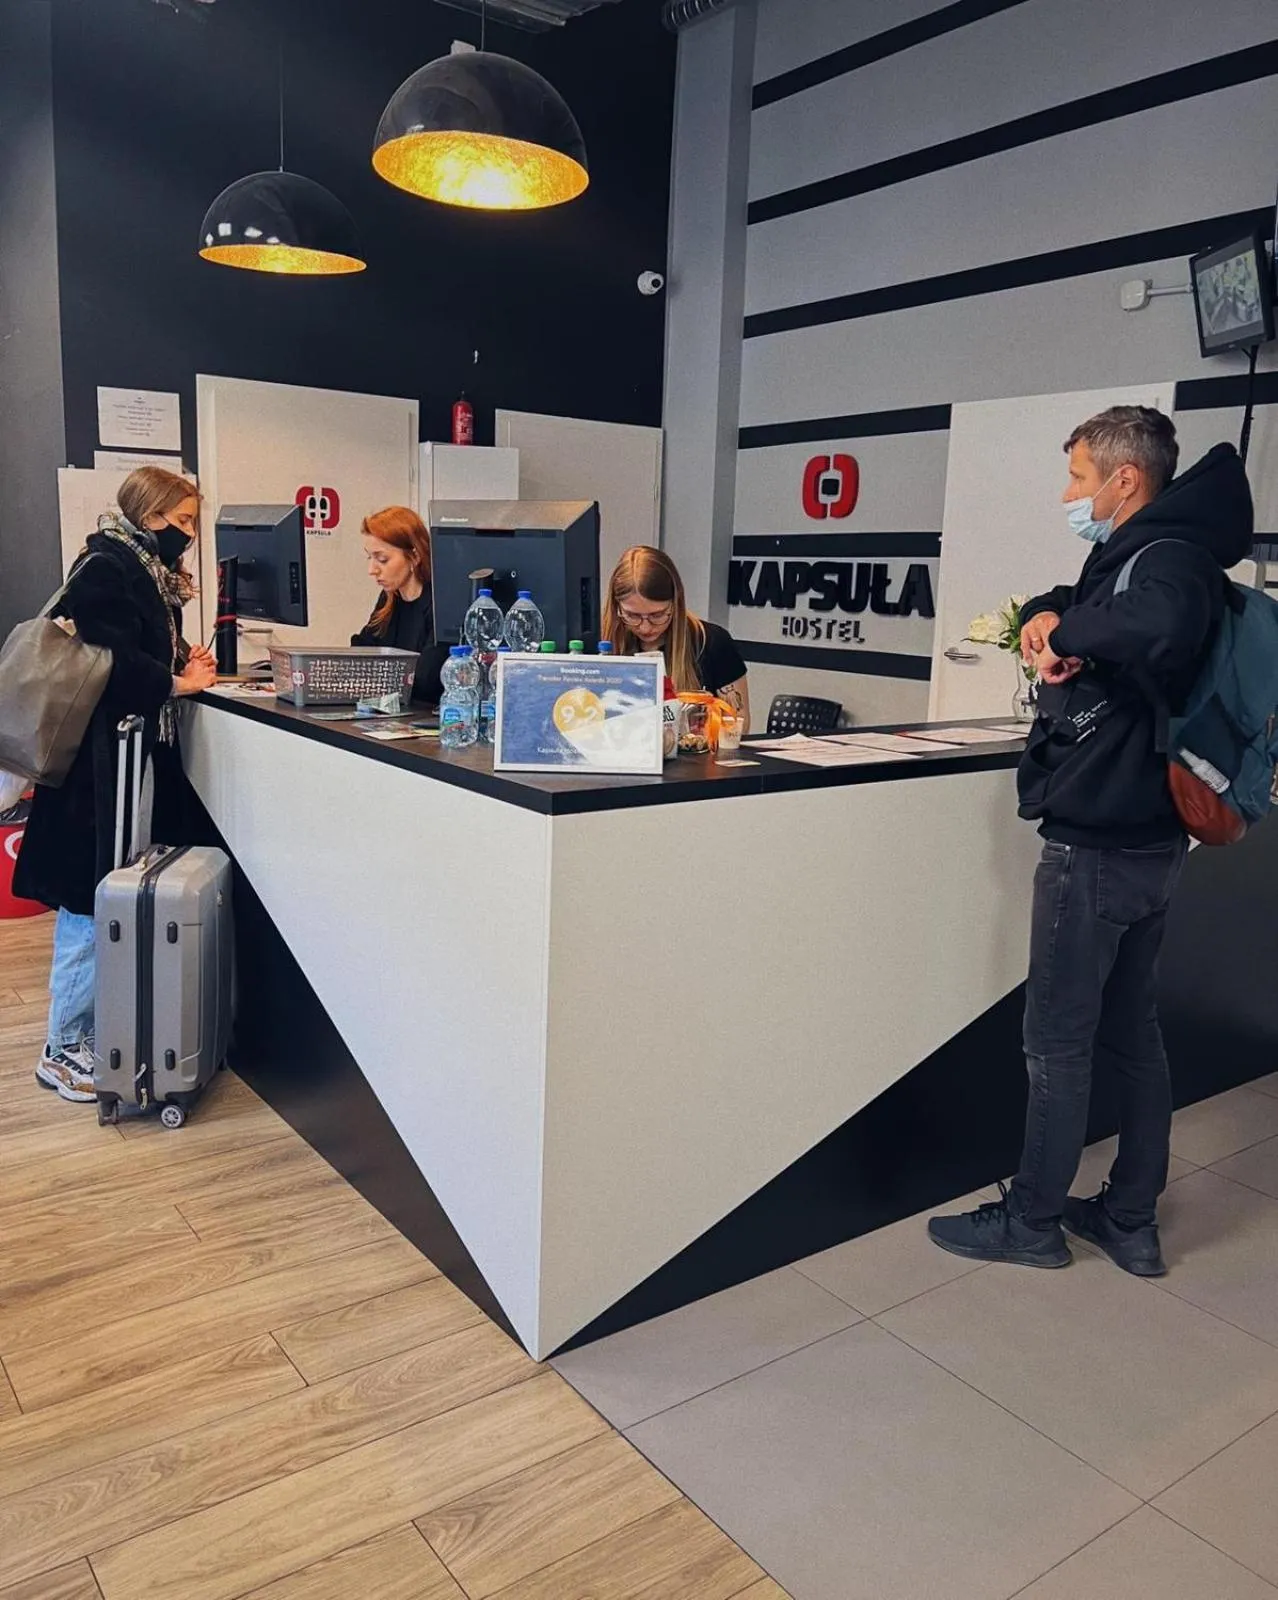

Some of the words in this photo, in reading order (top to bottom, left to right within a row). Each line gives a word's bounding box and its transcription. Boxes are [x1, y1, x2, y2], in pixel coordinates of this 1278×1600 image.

[727, 560, 936, 619] KAPSUŁA
[782, 616, 866, 644] HOSTEL
[560, 667, 600, 675] Booking.com
